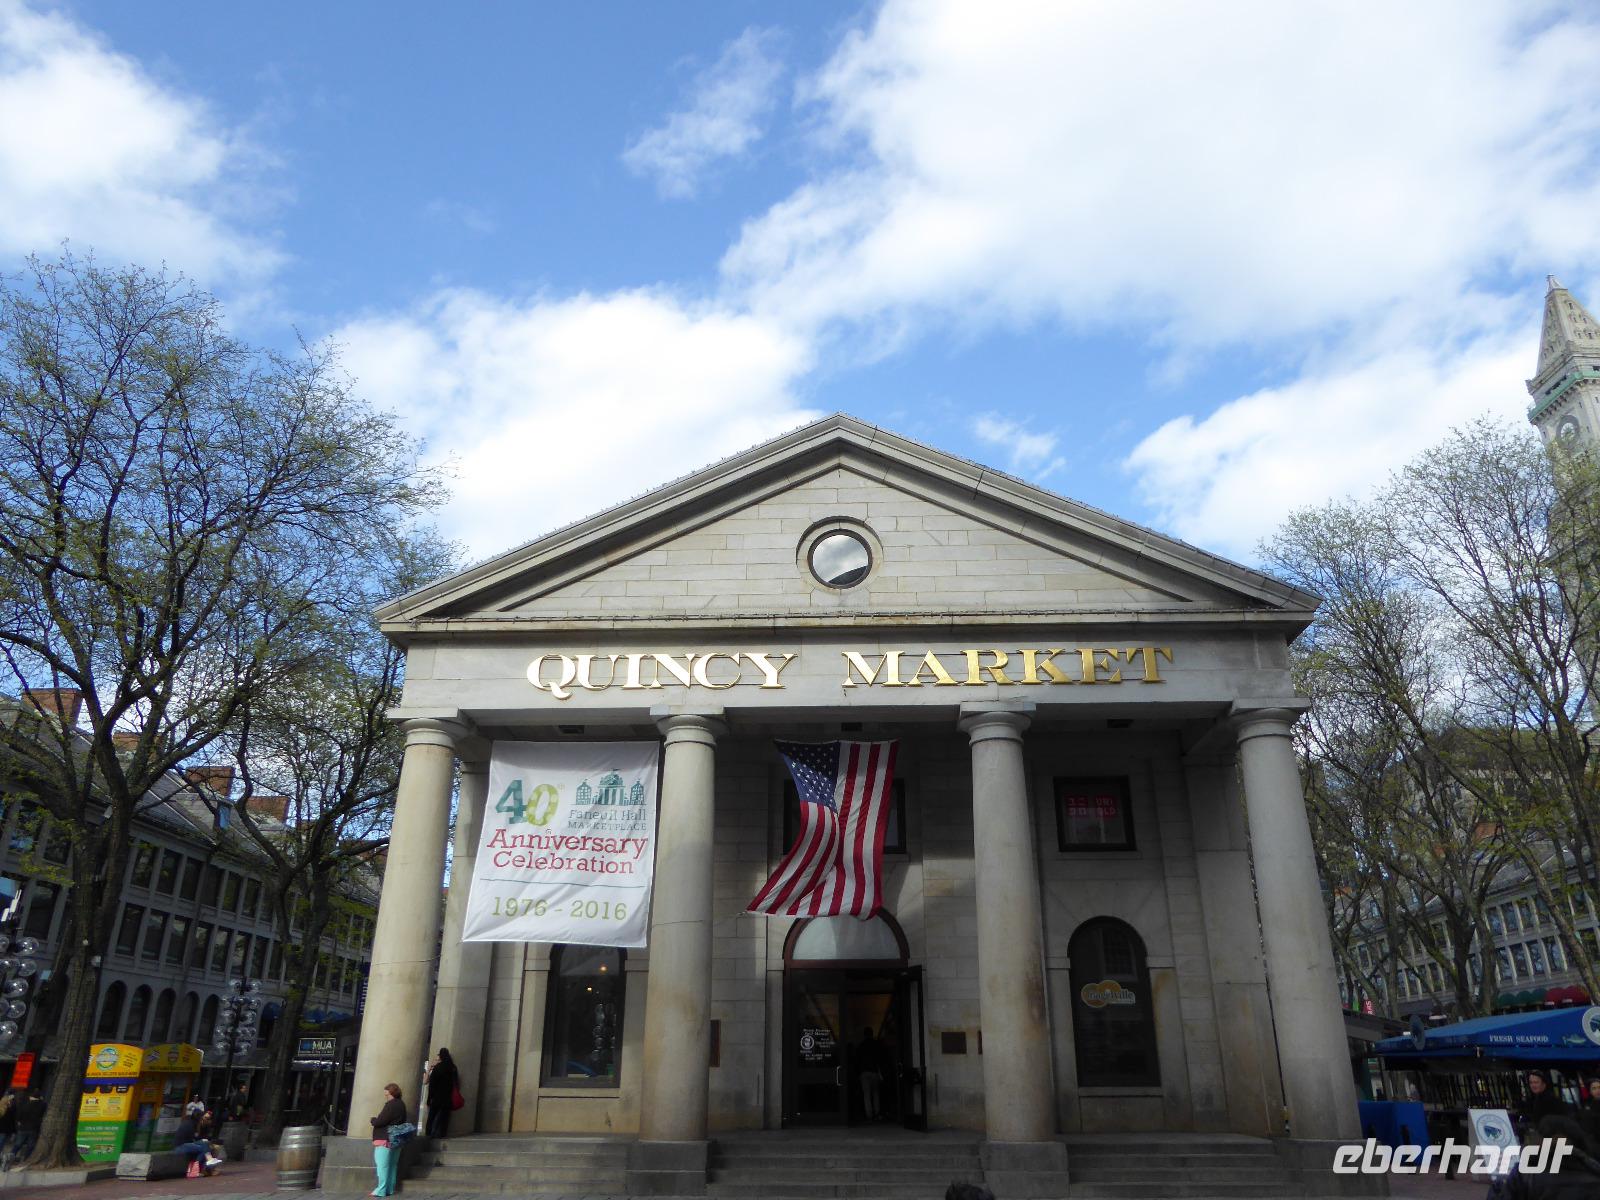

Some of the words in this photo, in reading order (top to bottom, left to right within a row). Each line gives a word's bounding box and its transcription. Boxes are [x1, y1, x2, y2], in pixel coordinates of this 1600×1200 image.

[526, 651, 798, 700] QUINCY
[841, 647, 1174, 688] MARKET
[568, 809, 617, 820] Faneuil
[622, 809, 647, 821] Hall
[568, 821, 647, 831] MARKETPLACE
[487, 828, 649, 860] Anniversary
[493, 851, 634, 874] Celebration
[491, 896, 548, 917] 1976
[570, 899, 628, 921] 2016
[1489, 1034, 1513, 1043] FRESH
[1516, 1034, 1549, 1043] SEAFOOD
